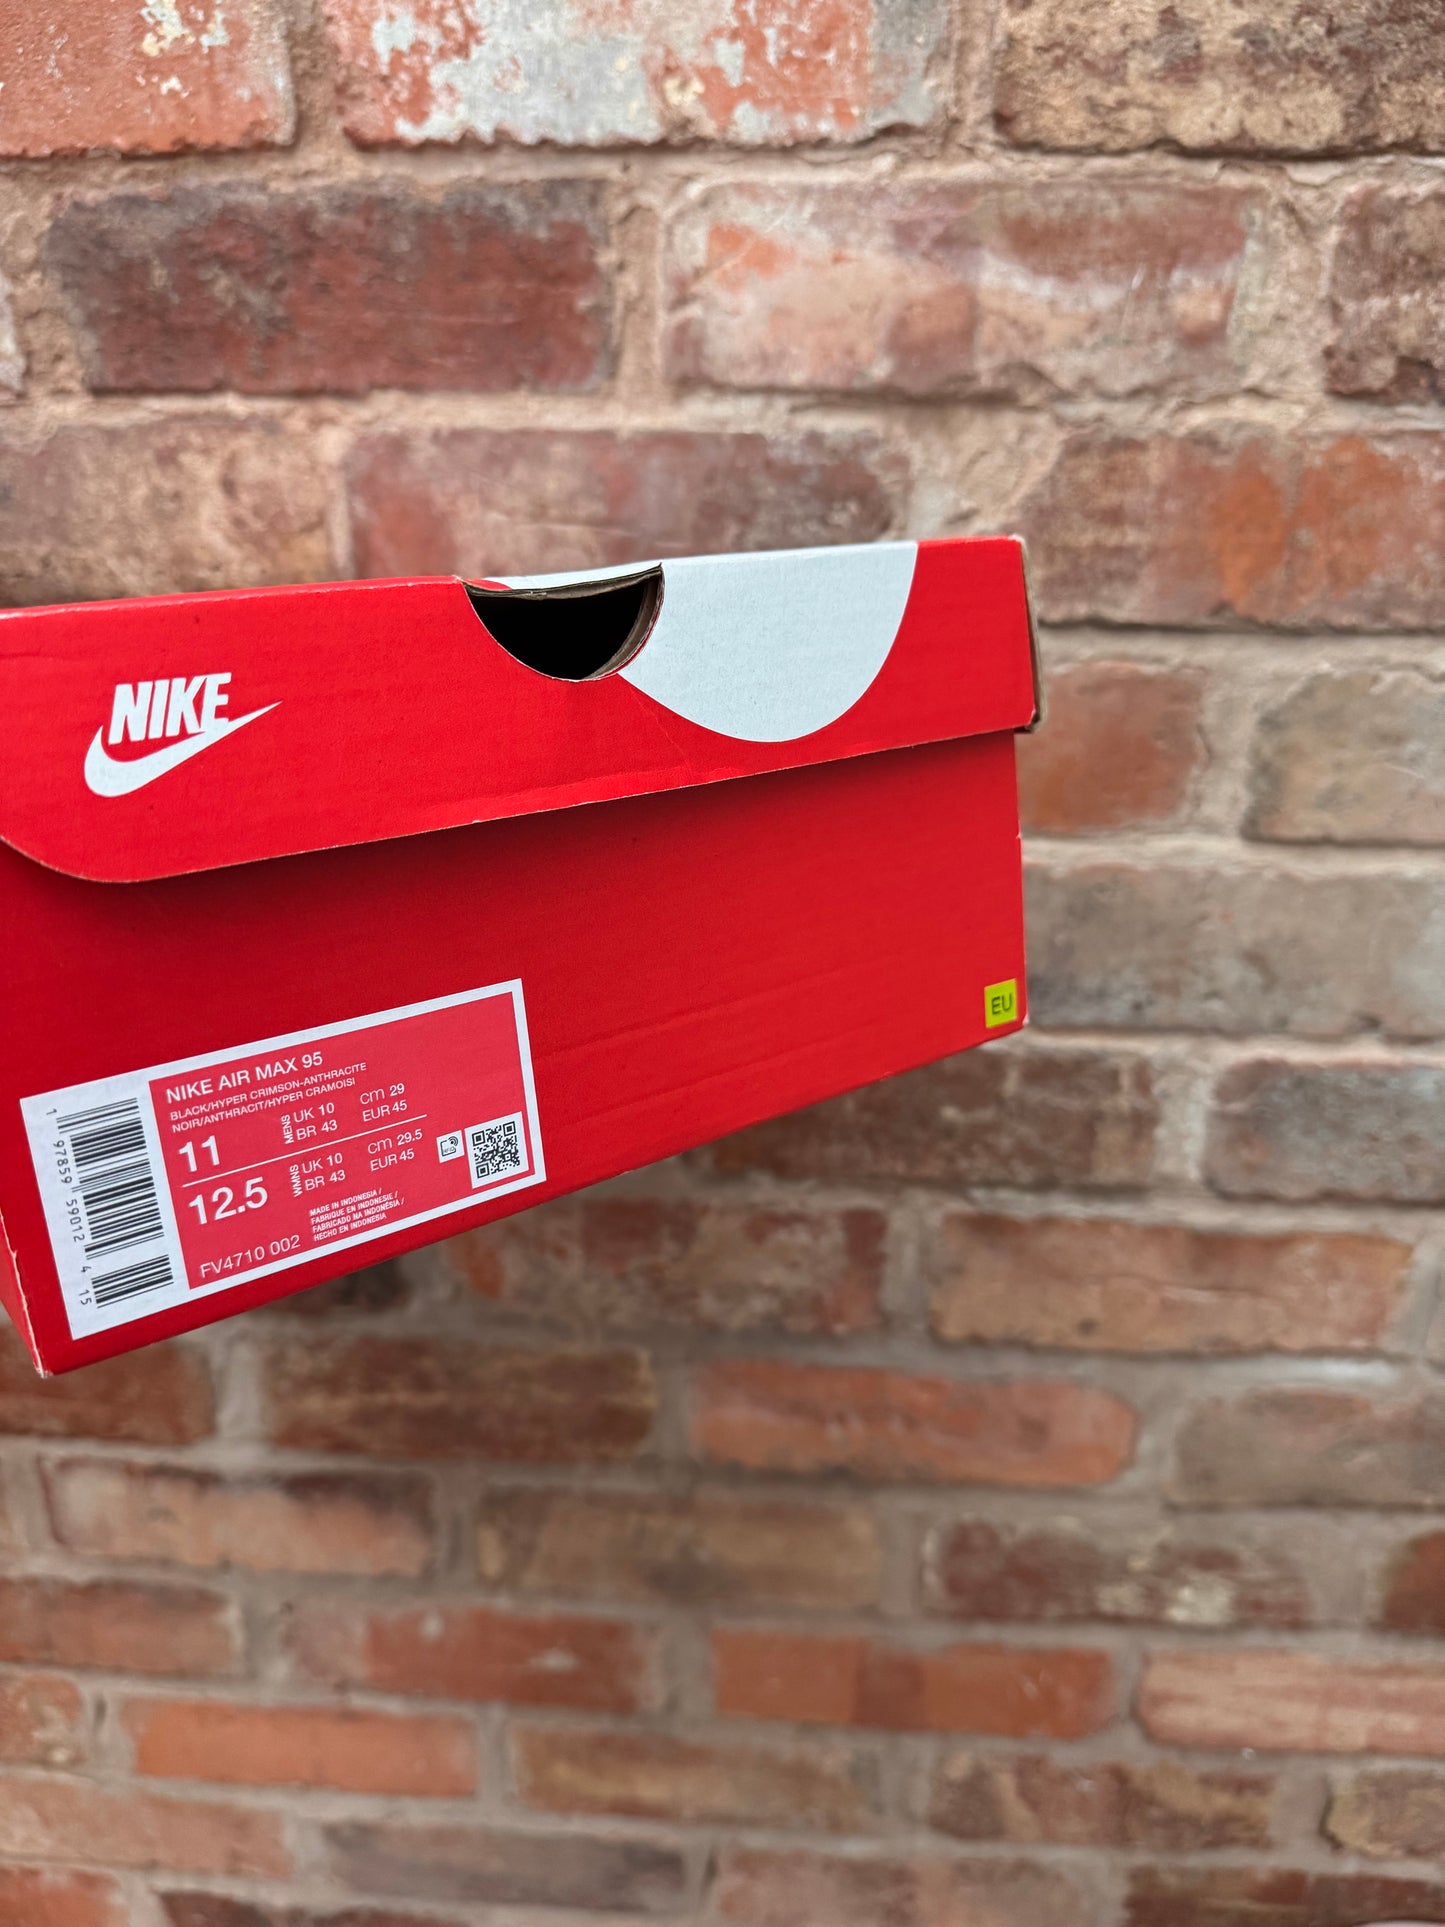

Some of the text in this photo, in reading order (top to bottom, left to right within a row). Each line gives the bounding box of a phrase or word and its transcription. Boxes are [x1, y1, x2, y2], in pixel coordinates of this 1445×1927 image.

[108, 672, 231, 745] NIKE
[992, 993, 1012, 1015] EU
[166, 1051, 323, 1104] NIKE AIR MAX 95
[389, 1083, 405, 1097] 29
[170, 1062, 366, 1121] BLACK/HYPER CRIMSON-ANTHRACITE
[172, 1077, 355, 1133] NOIR/ANTHRACIT/HYPER CRAMOISI
[293, 1102, 335, 1123] UK 10
[362, 1099, 408, 1122] EUR 45
[281, 1114, 294, 1144] MENS
[296, 1119, 338, 1140] BR 43
[397, 1129, 423, 1146] 29.5
[53, 1140, 72, 1184] 97859
[178, 1135, 220, 1172] 11
[302, 1152, 343, 1174] UK 10
[370, 1148, 415, 1171] EUR 45
[290, 1164, 302, 1197] WMNS
[305, 1169, 346, 1191] BR 43
[188, 1176, 268, 1225] 12.5
[309, 1204, 330, 1216] MADE
[331, 1201, 339, 1210] IN
[341, 1189, 377, 1206] INDONESIA
[66, 1199, 85, 1242] 59012
[311, 1209, 345, 1225] FABRIQUE
[346, 1206, 356, 1214] EN
[312, 1215, 351, 1233] FABRICADO
[353, 1212, 363, 1220] NA
[313, 1212, 387, 1241] HECHO EN INDONESIA
[200, 1234, 301, 1278] FV4710 002
[81, 1265, 92, 1273] 4
[78, 1289, 92, 1305] 15
